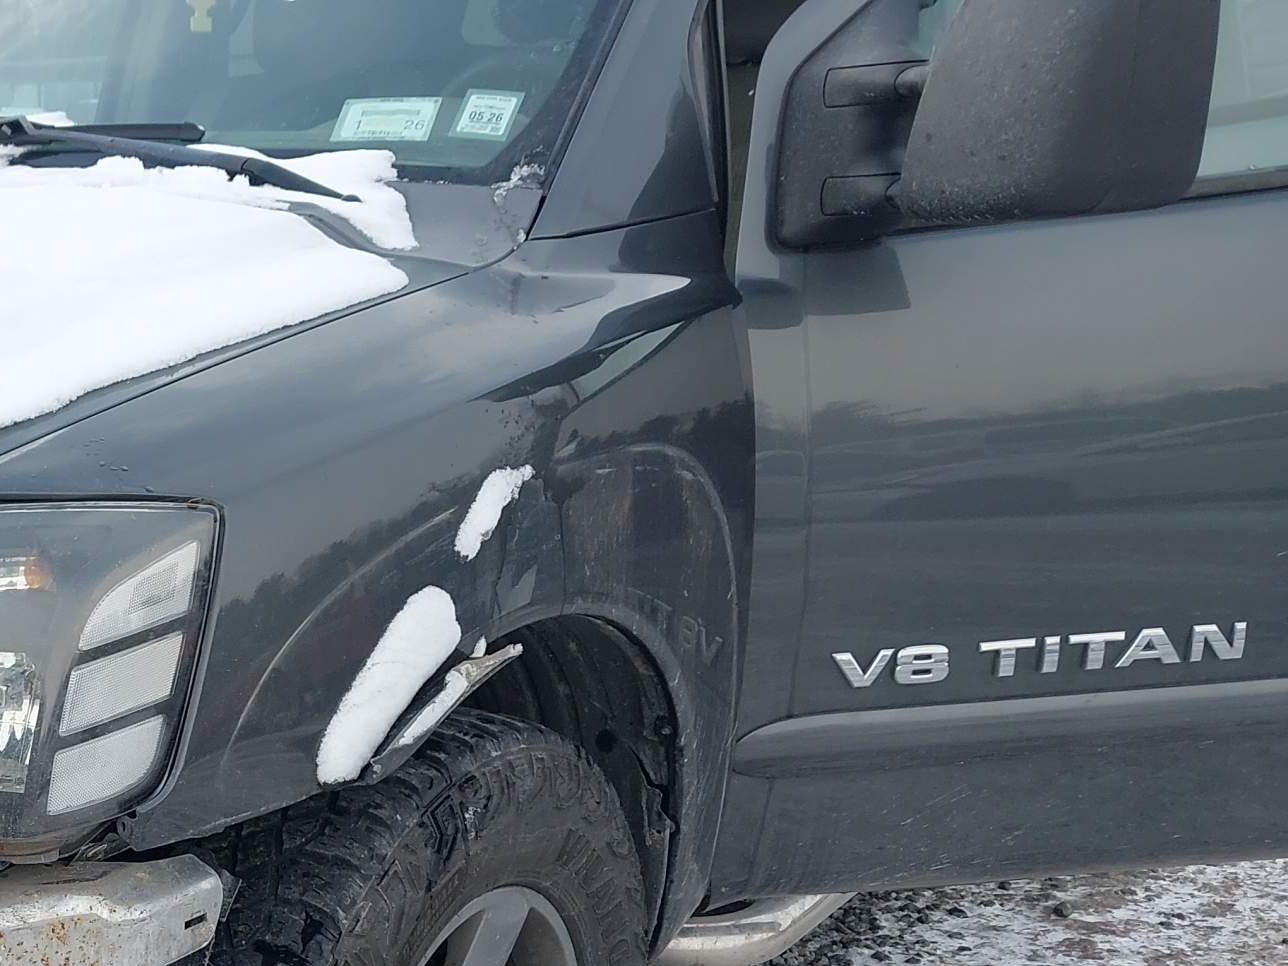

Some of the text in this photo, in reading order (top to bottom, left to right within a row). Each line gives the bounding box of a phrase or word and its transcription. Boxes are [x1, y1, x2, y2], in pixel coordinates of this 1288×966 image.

[469, 110, 504, 123] 05 26
[403, 119, 426, 131] 26
[831, 621, 1247, 688] V8 TITAN
